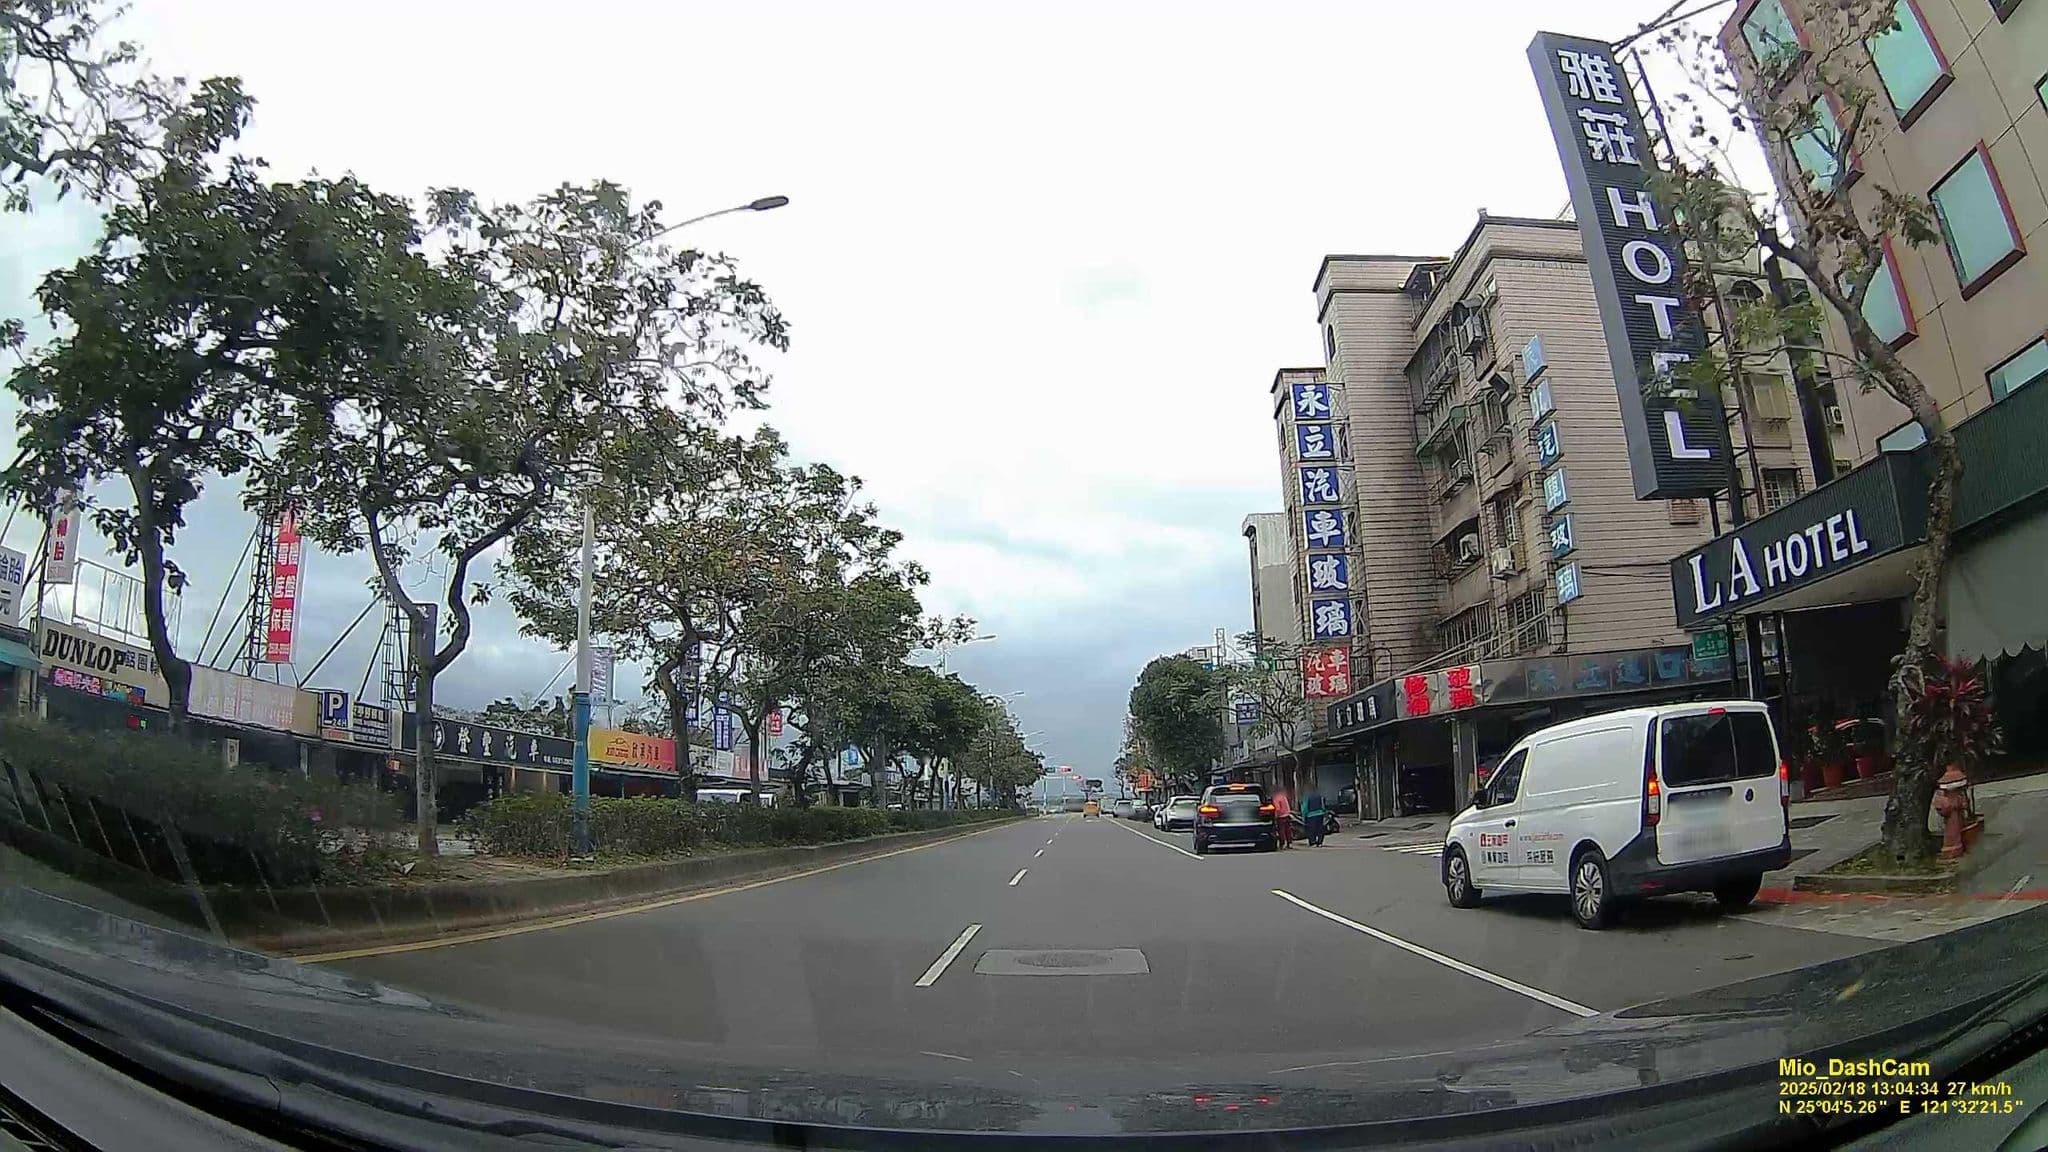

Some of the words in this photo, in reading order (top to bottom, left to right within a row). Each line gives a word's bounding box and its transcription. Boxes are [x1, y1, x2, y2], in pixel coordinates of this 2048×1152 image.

[1557, 48, 1639, 166] 雅莊
[1606, 186, 1711, 460] HOTEL
[1296, 387, 1350, 638] 永立汽車玻璃
[1687, 537, 1760, 614] LA
[1763, 508, 1869, 588] HOTEL
[42, 629, 127, 674] DUNLOP
[329, 693, 343, 717] P
